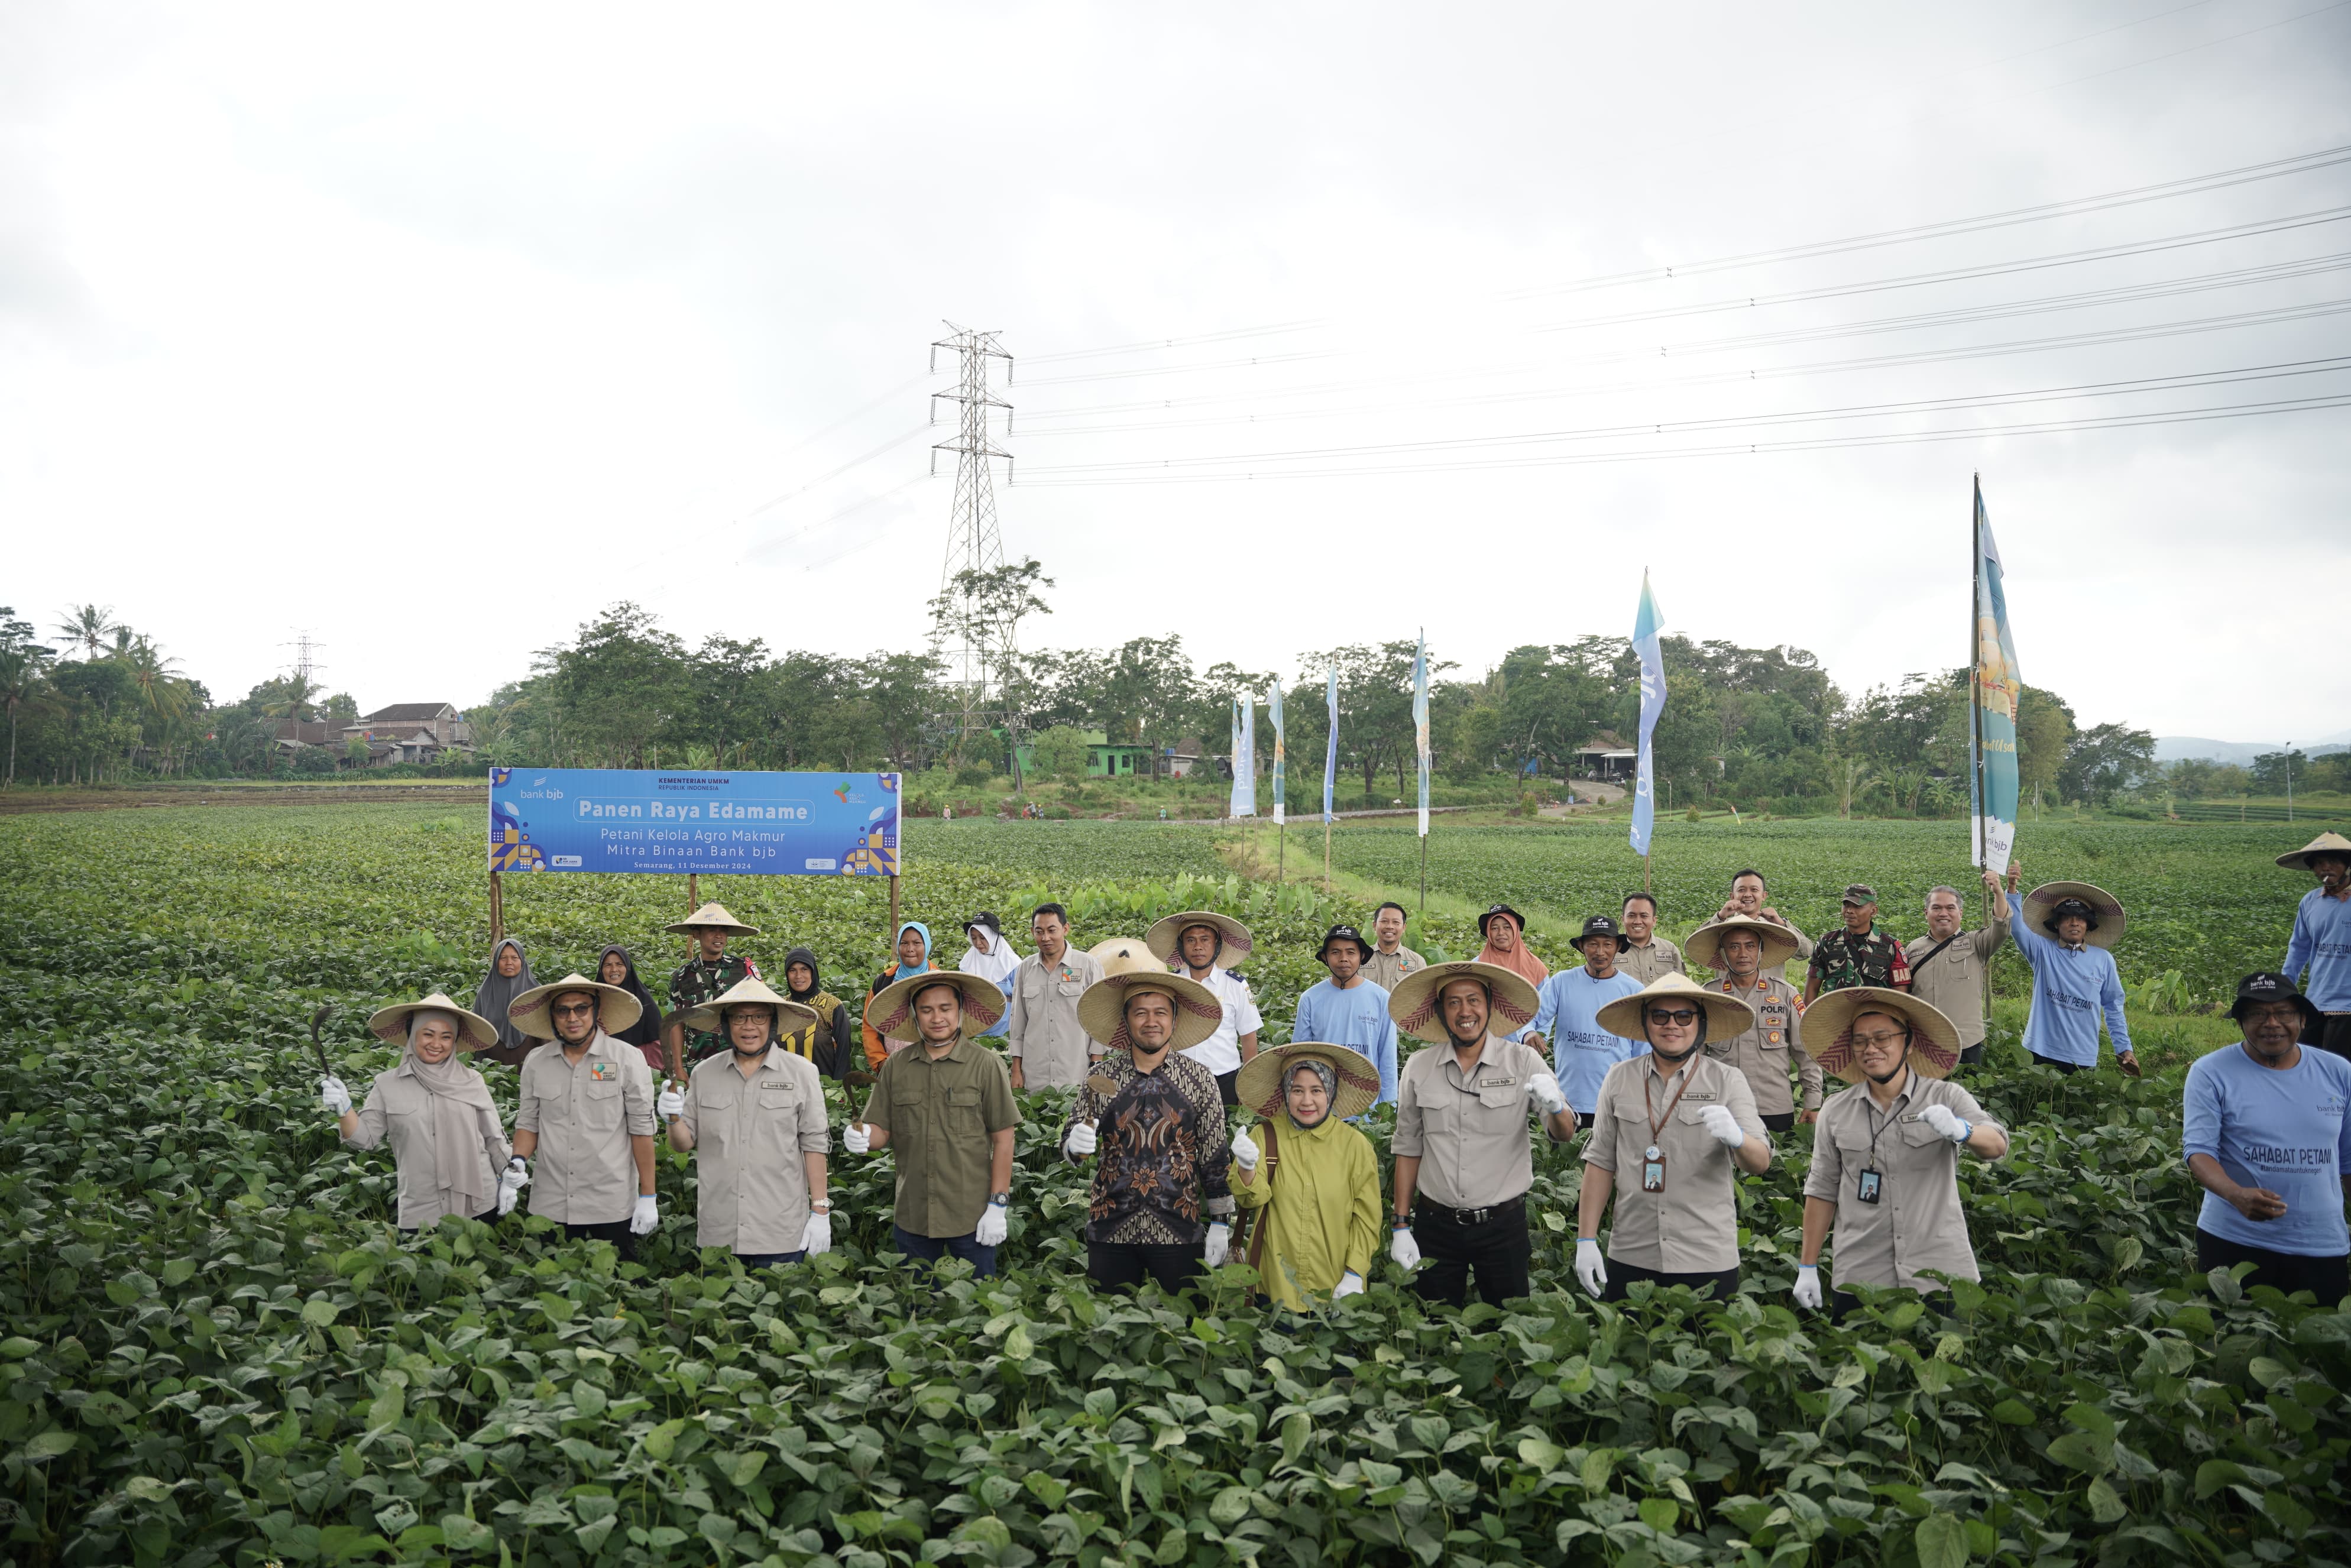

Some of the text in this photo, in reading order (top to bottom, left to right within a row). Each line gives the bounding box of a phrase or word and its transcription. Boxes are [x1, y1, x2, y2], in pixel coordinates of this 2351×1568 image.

[520, 788, 564, 801] bank bjb
[579, 800, 808, 822] Panen Raya Edamame
[601, 828, 785, 844] Petani Kelola Agro Makmur
[607, 844, 776, 859] Mitra Binaan Bank bjb
[1994, 838, 2007, 851] bjb
[634, 861, 675, 870] Semarang,
[2046, 987, 2094, 1010] SAHABAT PETANI
[1568, 1031, 1620, 1048] SAHABAT PETANI
[2243, 1147, 2331, 1165] SAHABAT PETANI
[2261, 1165, 2322, 1175] #tandamatauntuknegeri
